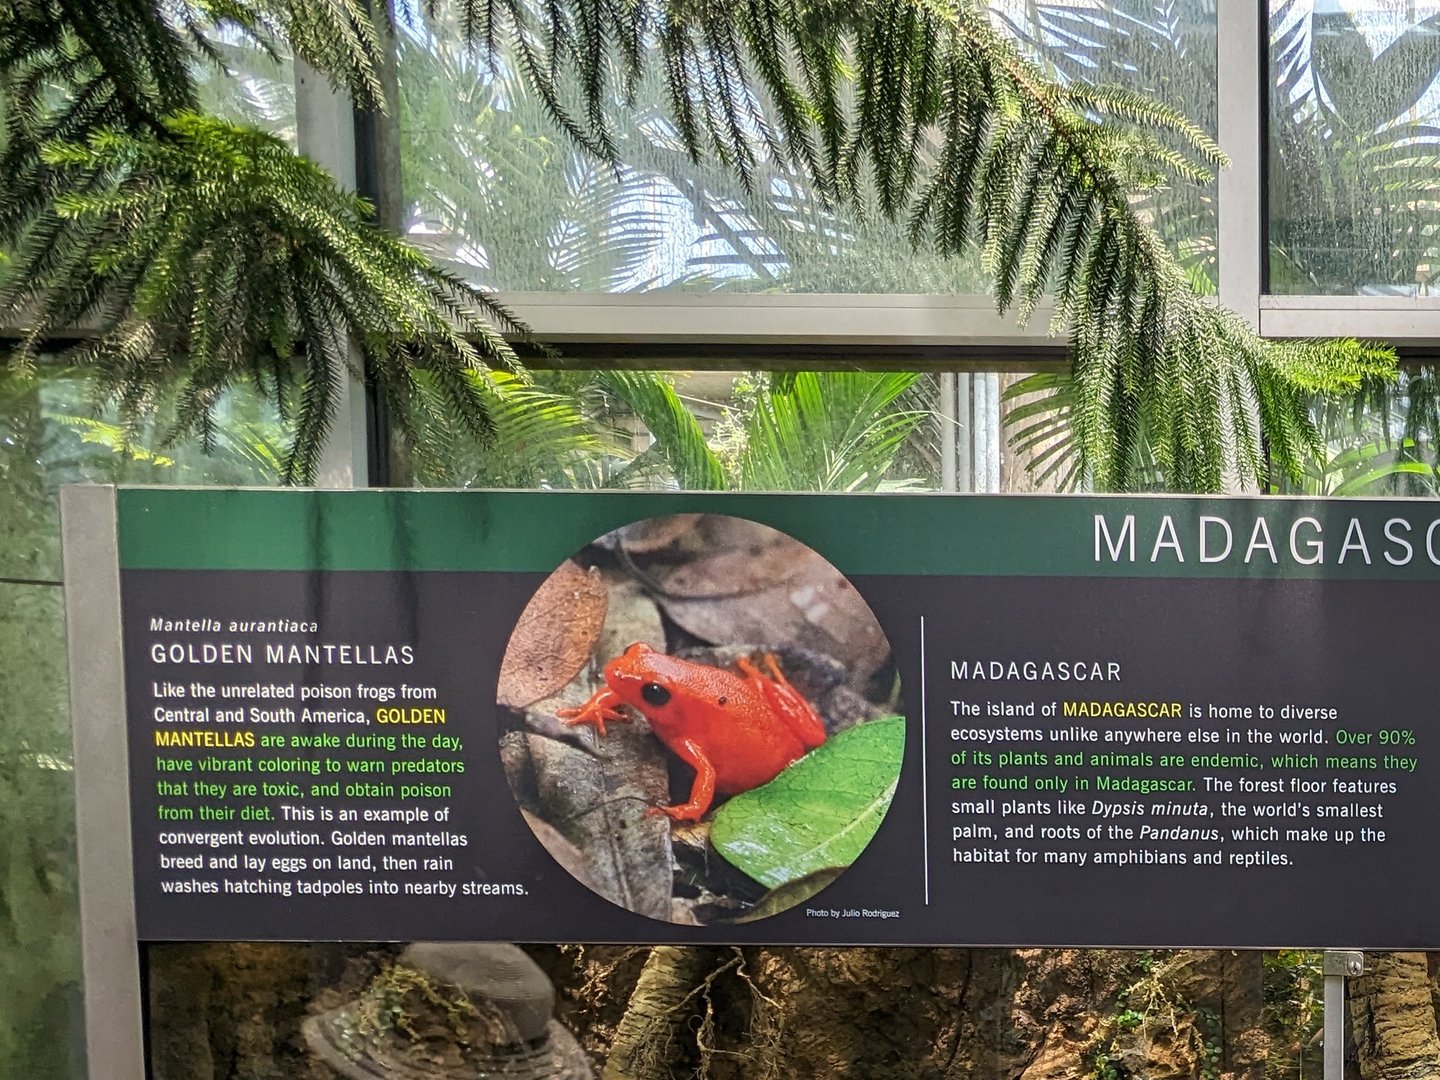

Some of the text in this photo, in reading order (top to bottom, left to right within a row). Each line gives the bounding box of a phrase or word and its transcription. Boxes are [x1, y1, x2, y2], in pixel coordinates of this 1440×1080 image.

[150, 617, 317, 633] Mantella aurantiaca
[151, 643, 414, 664] GOLDEN MANTELLAS
[951, 661, 1120, 681] MADAGASCAR
[153, 682, 436, 702] Like the unrelated poison frogs from
[154, 706, 445, 725] Central and South America, GOLDEN
[950, 700, 1337, 719] The island of MADAGASCAR is home to diverse
[155, 730, 462, 751] MANTELLAS are awake during the day,
[950, 726, 1415, 745] ecosystems unlike anywhere else in the world. Over 90%
[156, 756, 464, 775] have vibrant coloring to warn predators
[952, 774, 1396, 794] are found only in Madagascar. The forest floor features
[952, 799, 1383, 818] small plants like Dypsis minuta, the world's smallest
[159, 829, 468, 848] convergent evolution. Golden mantellas
[953, 847, 1292, 868] habitat for many amphibians and reptiles.
[160, 878, 528, 898] washes hatching tadpoles into nearby streams.
[806, 908, 900, 919] Photo by Julio Rodriguez
